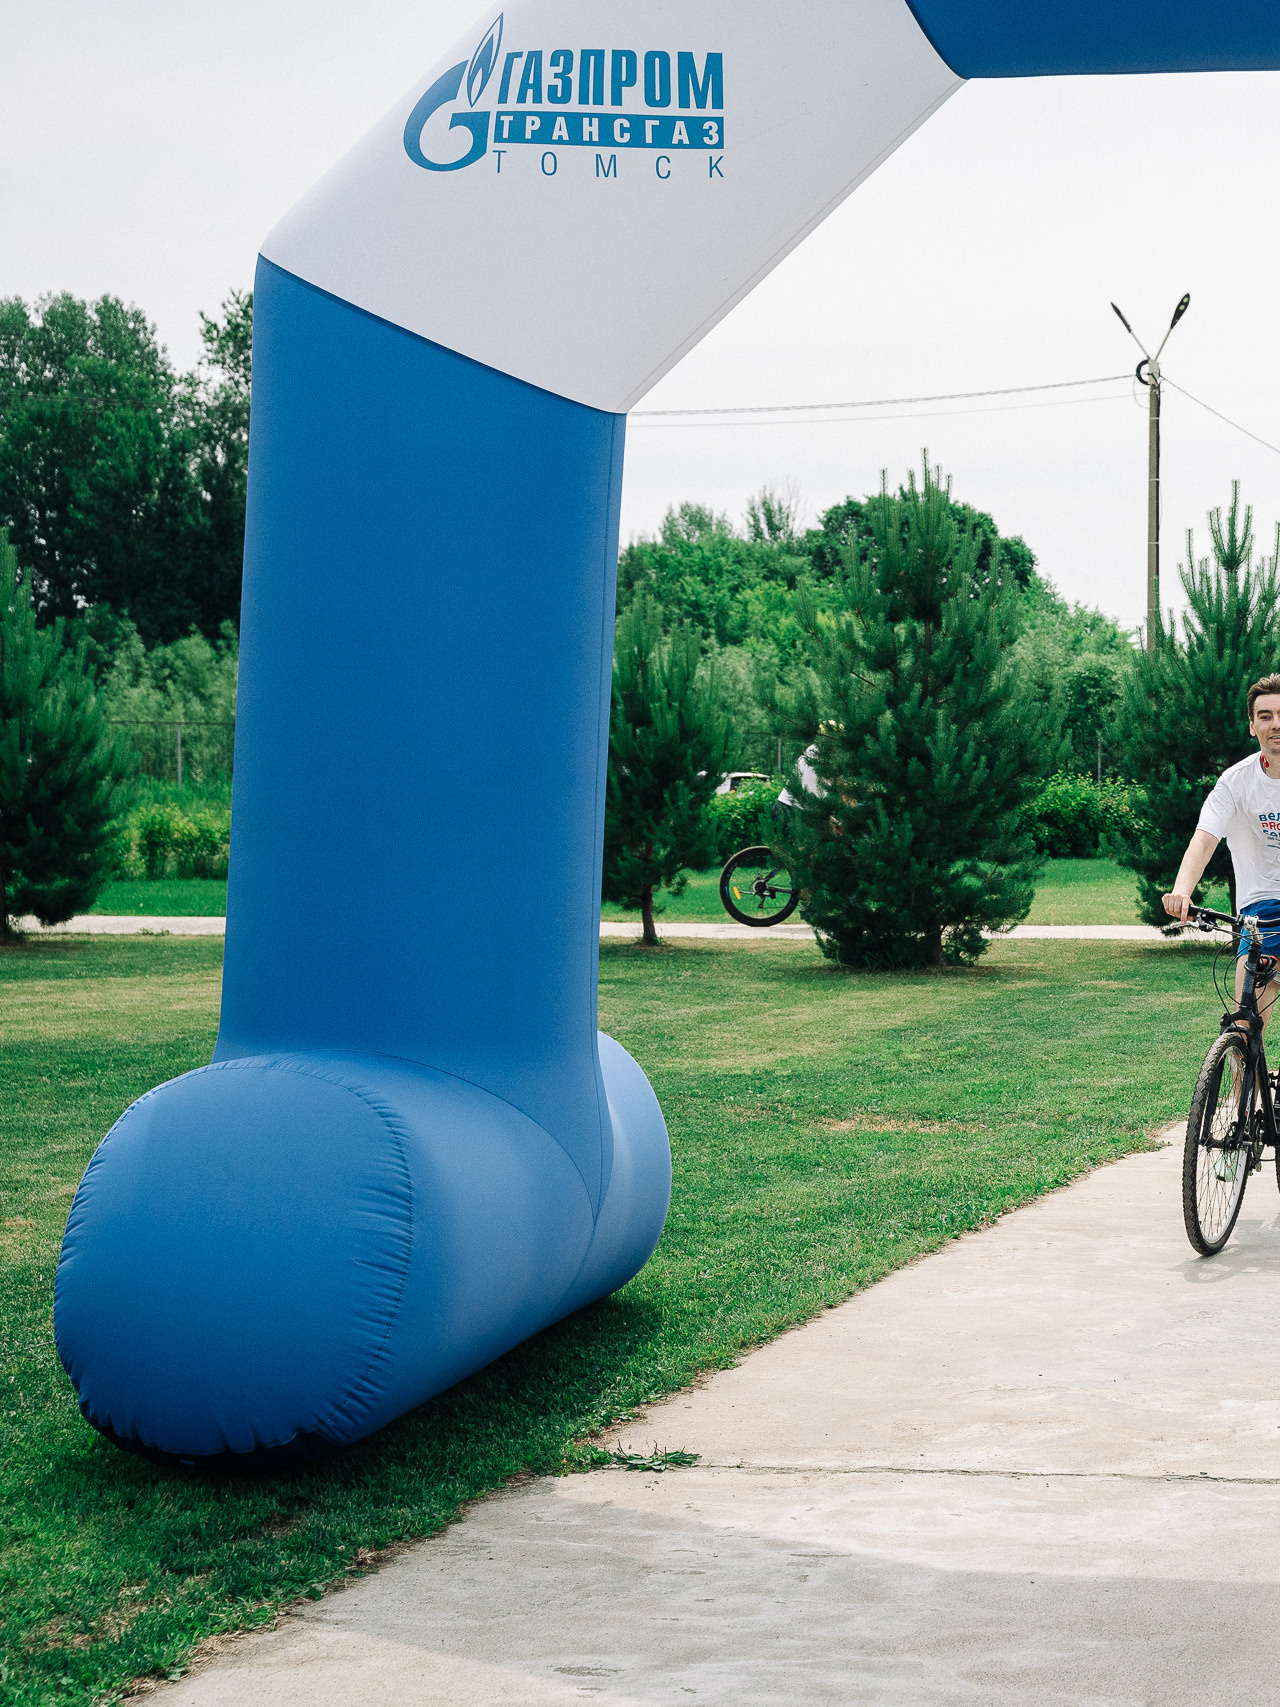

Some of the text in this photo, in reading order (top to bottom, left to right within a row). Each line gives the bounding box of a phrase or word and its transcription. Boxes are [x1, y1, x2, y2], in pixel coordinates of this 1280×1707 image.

[497, 49, 724, 110] ГАЗПРОМ
[500, 115, 720, 145] ТРАНСГАЗ
[492, 150, 725, 179] ТОМСК
